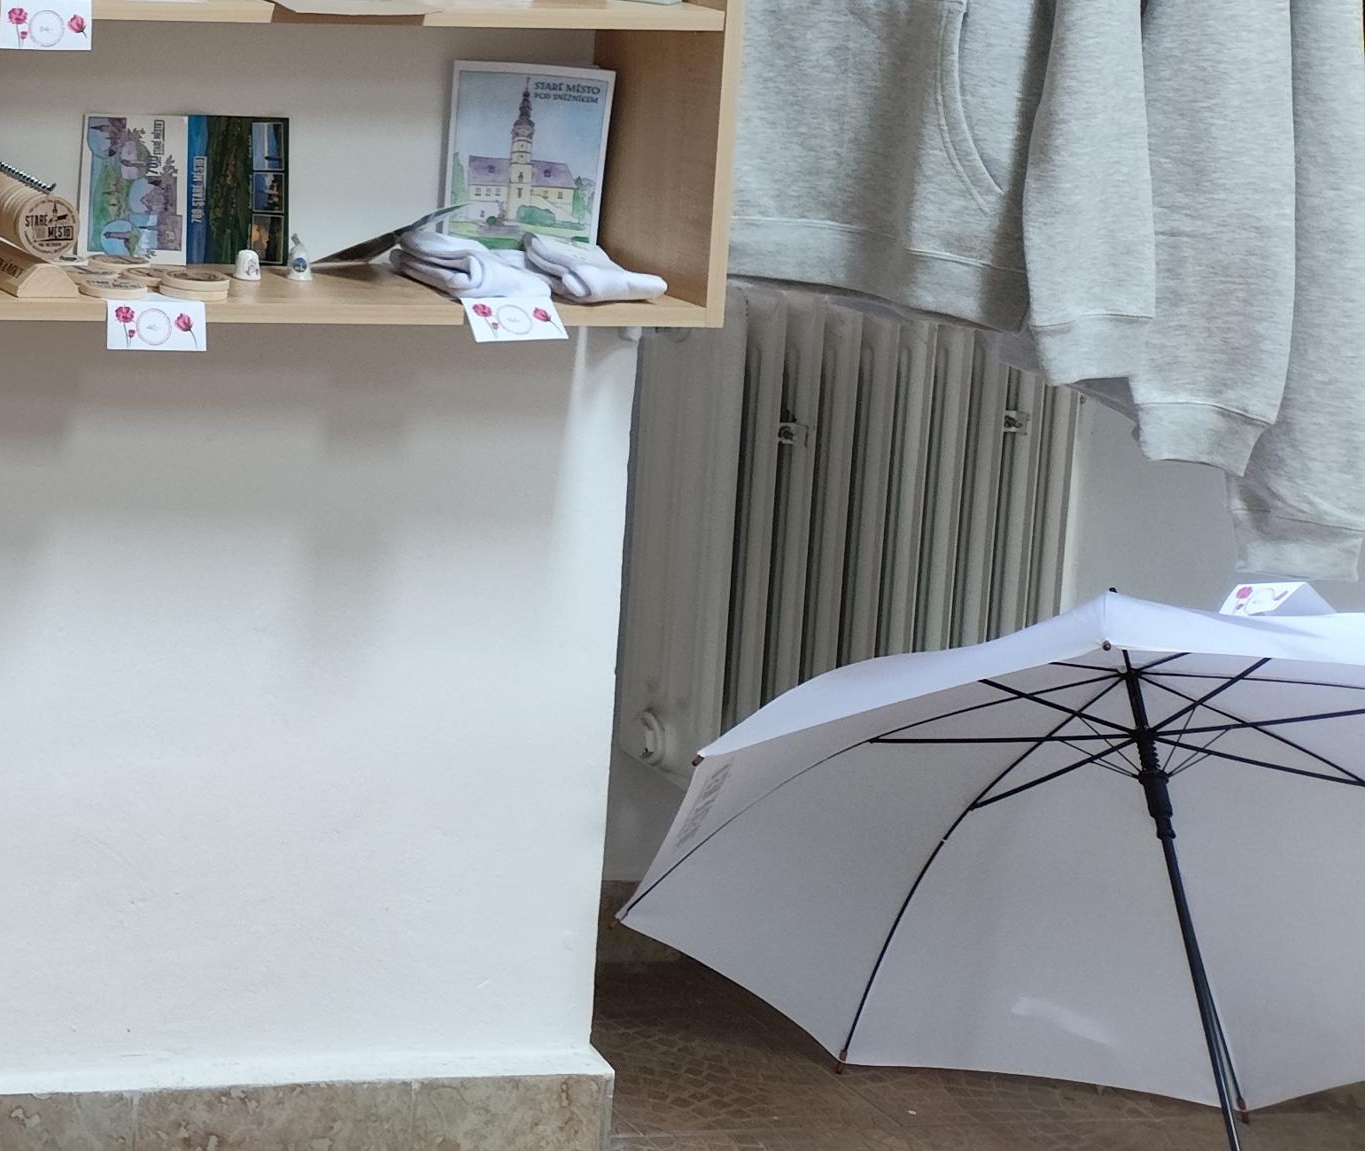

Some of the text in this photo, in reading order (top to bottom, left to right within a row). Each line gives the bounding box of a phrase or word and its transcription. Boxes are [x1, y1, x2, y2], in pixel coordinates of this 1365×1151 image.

[534, 81, 601, 95] STARÉ MĚSTO
[25, 212, 48, 227] STARÉ
